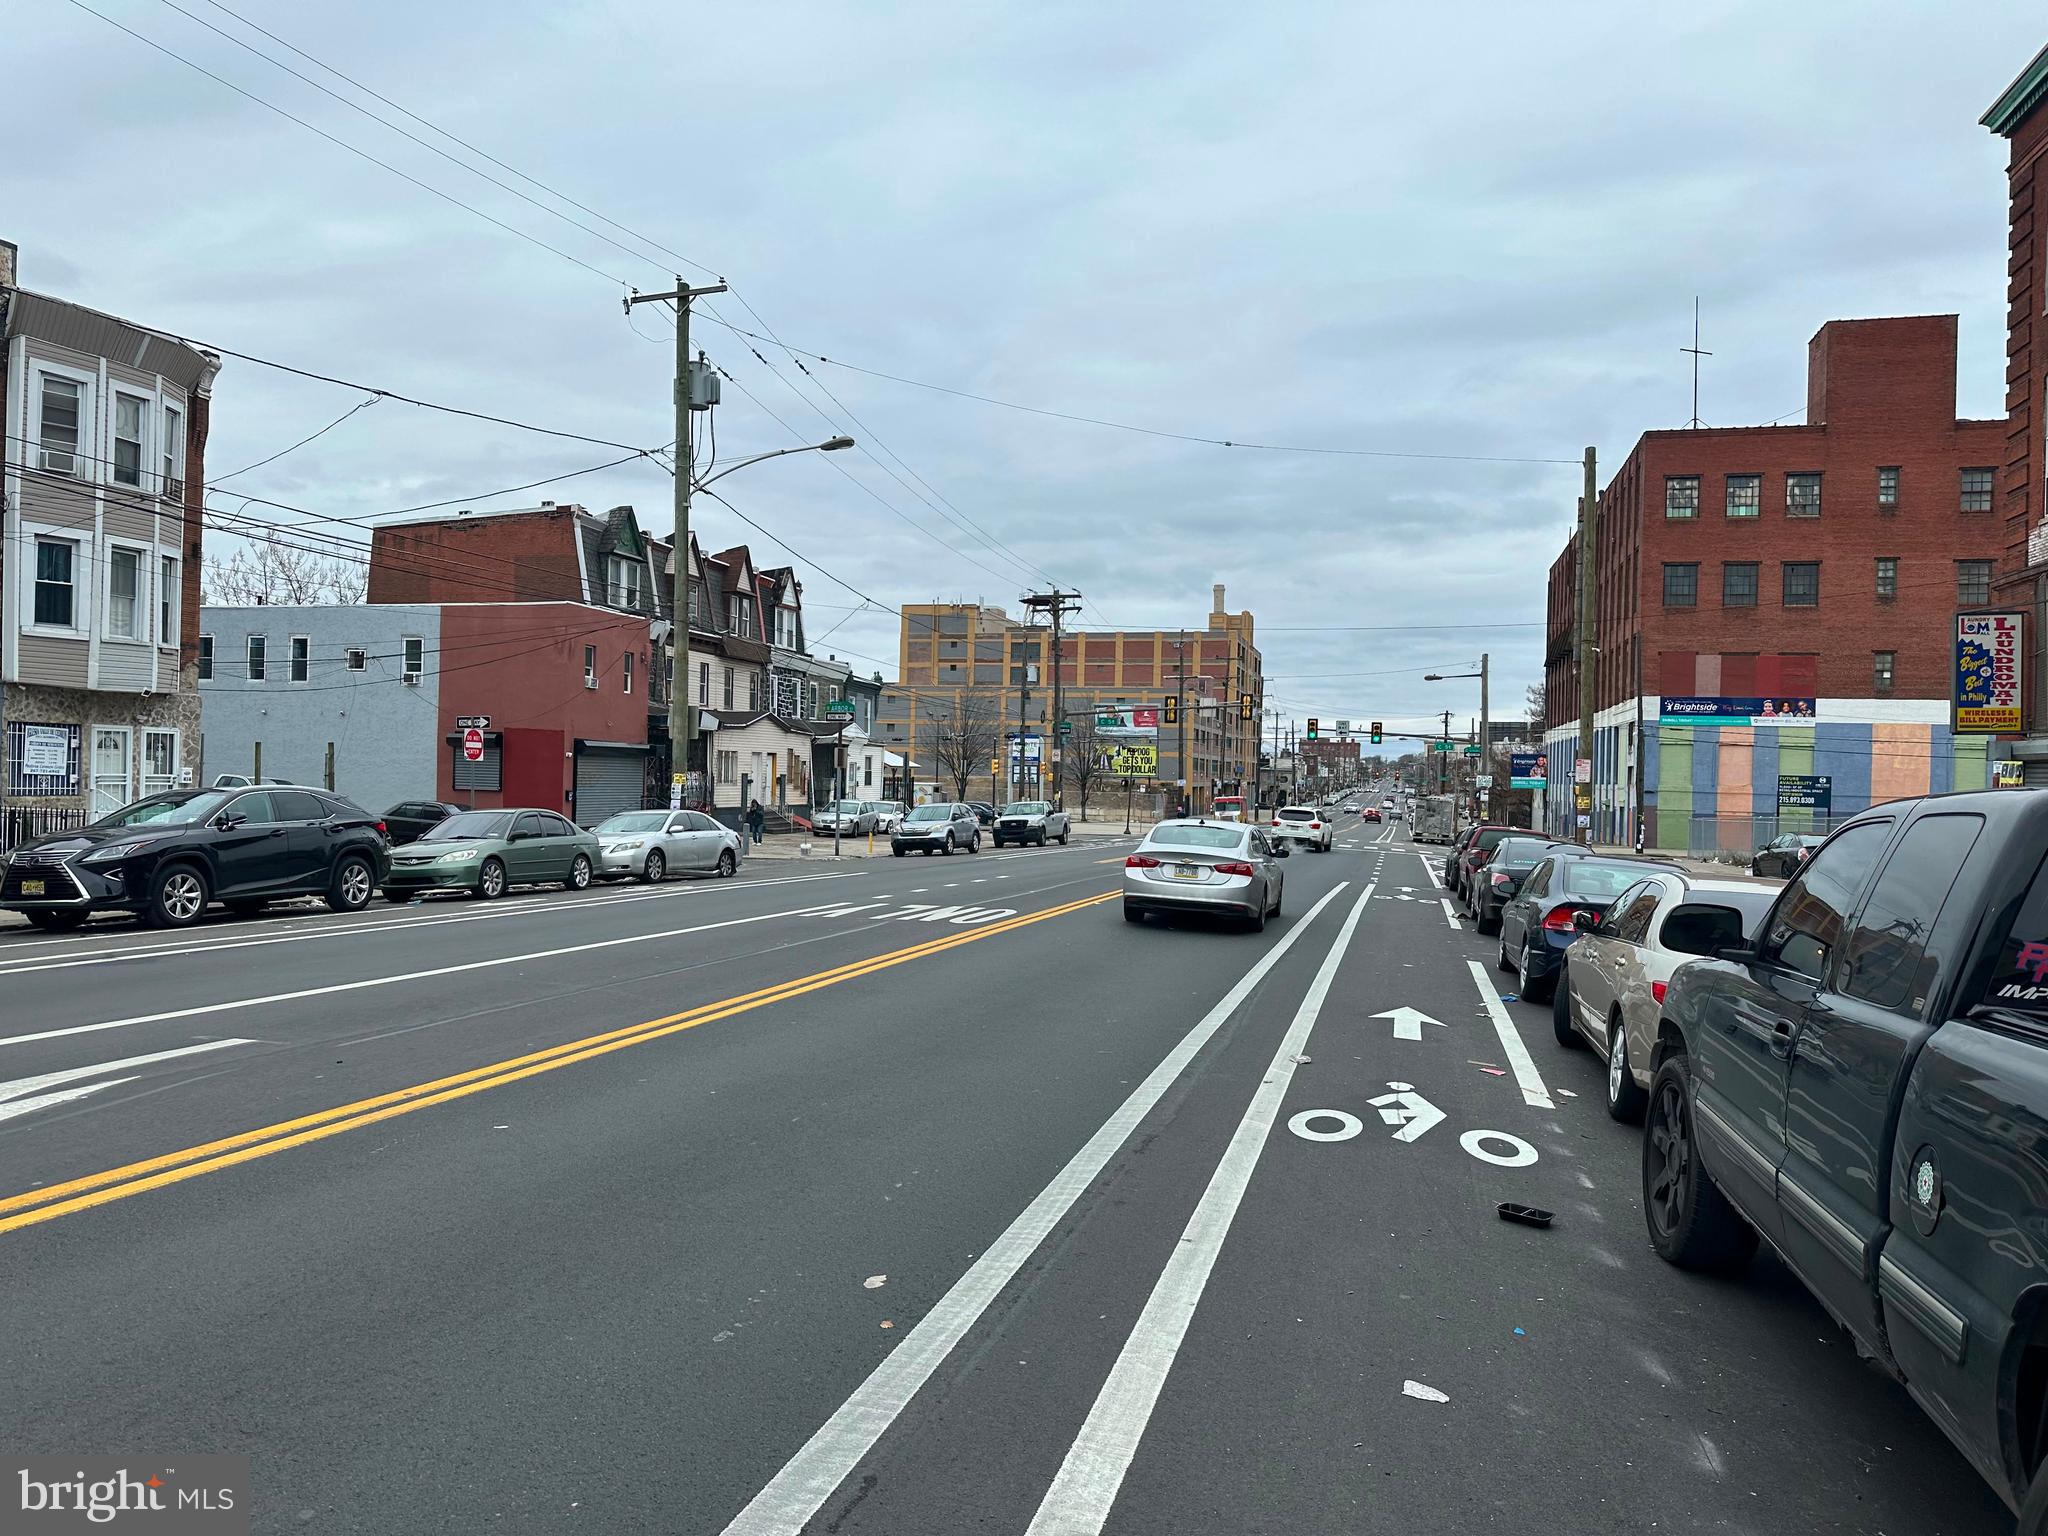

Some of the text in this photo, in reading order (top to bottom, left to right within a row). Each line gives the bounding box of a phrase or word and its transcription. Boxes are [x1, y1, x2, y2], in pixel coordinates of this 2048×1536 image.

[1960, 656, 1987, 671] Biggest
[1991, 617, 2017, 706] LAUNDROMAT
[1965, 676, 1983, 691] Best
[1960, 693, 1987, 703] in Philly
[1673, 703, 1718, 712] Brightside
[1119, 765, 1156, 773] TOP DOLLAR
[1997, 984, 2048, 999] IMP
